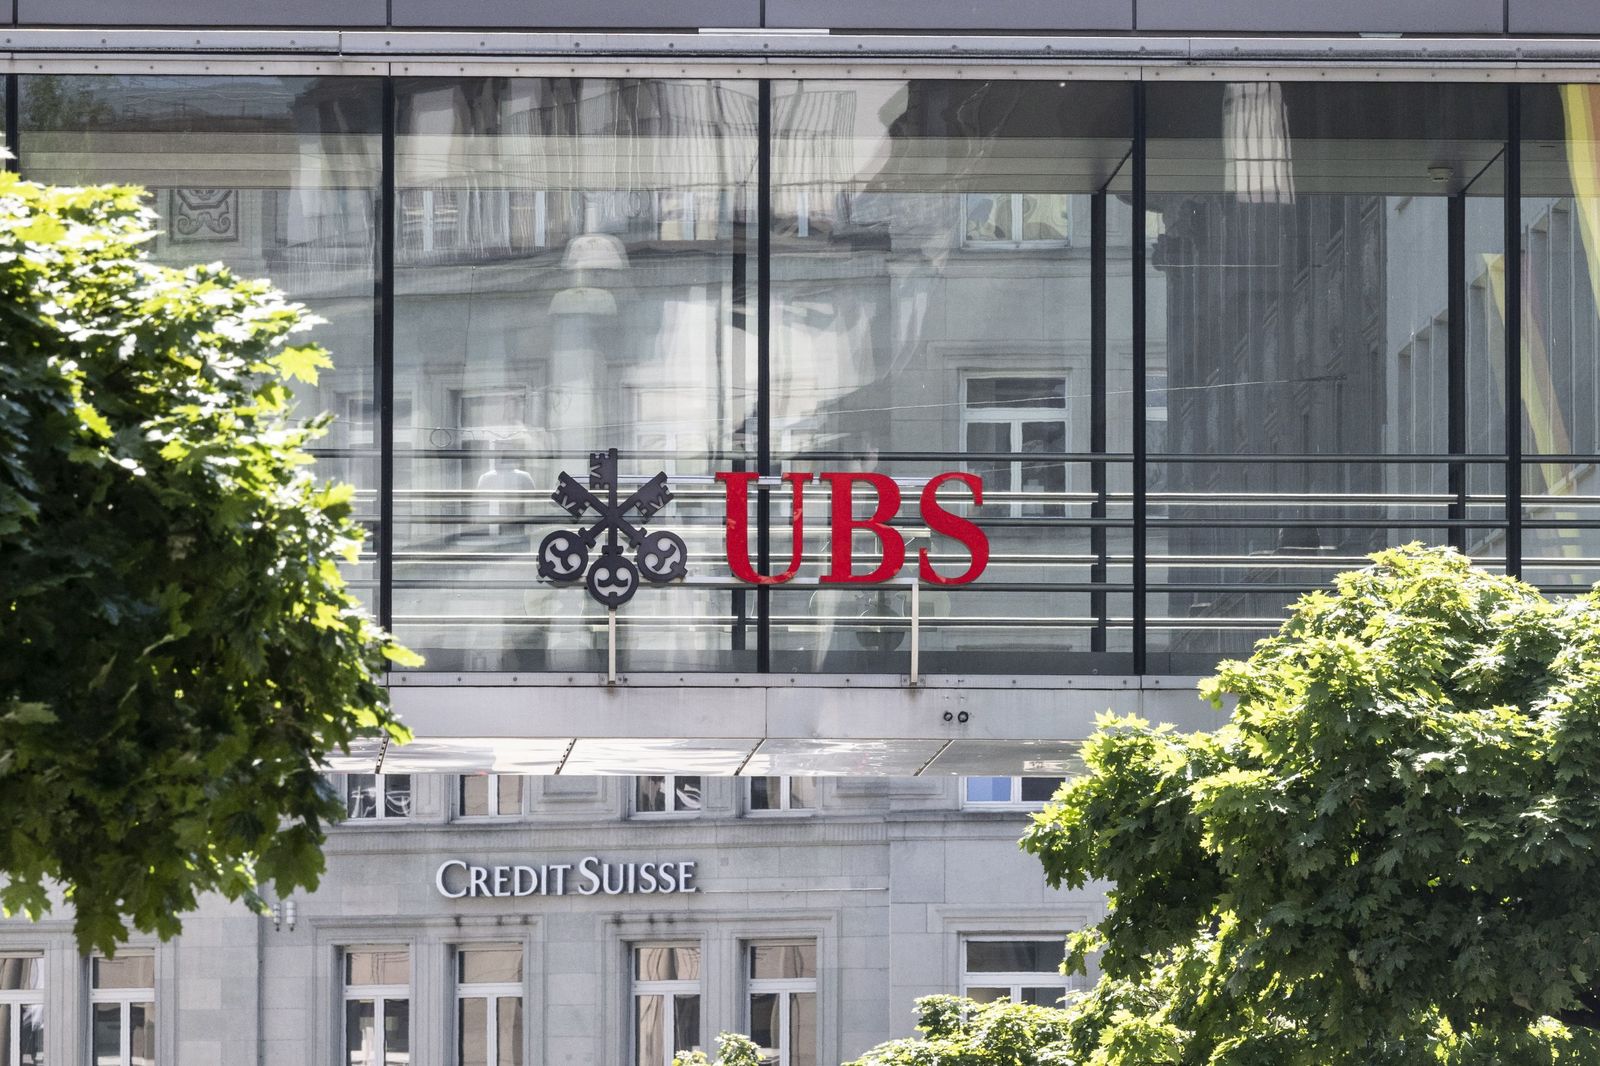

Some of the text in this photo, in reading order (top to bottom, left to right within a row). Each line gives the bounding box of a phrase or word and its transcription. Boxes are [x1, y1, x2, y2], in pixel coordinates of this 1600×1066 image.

[715, 472, 989, 585] UBS
[436, 856, 697, 898] CREDIT SUISSE
